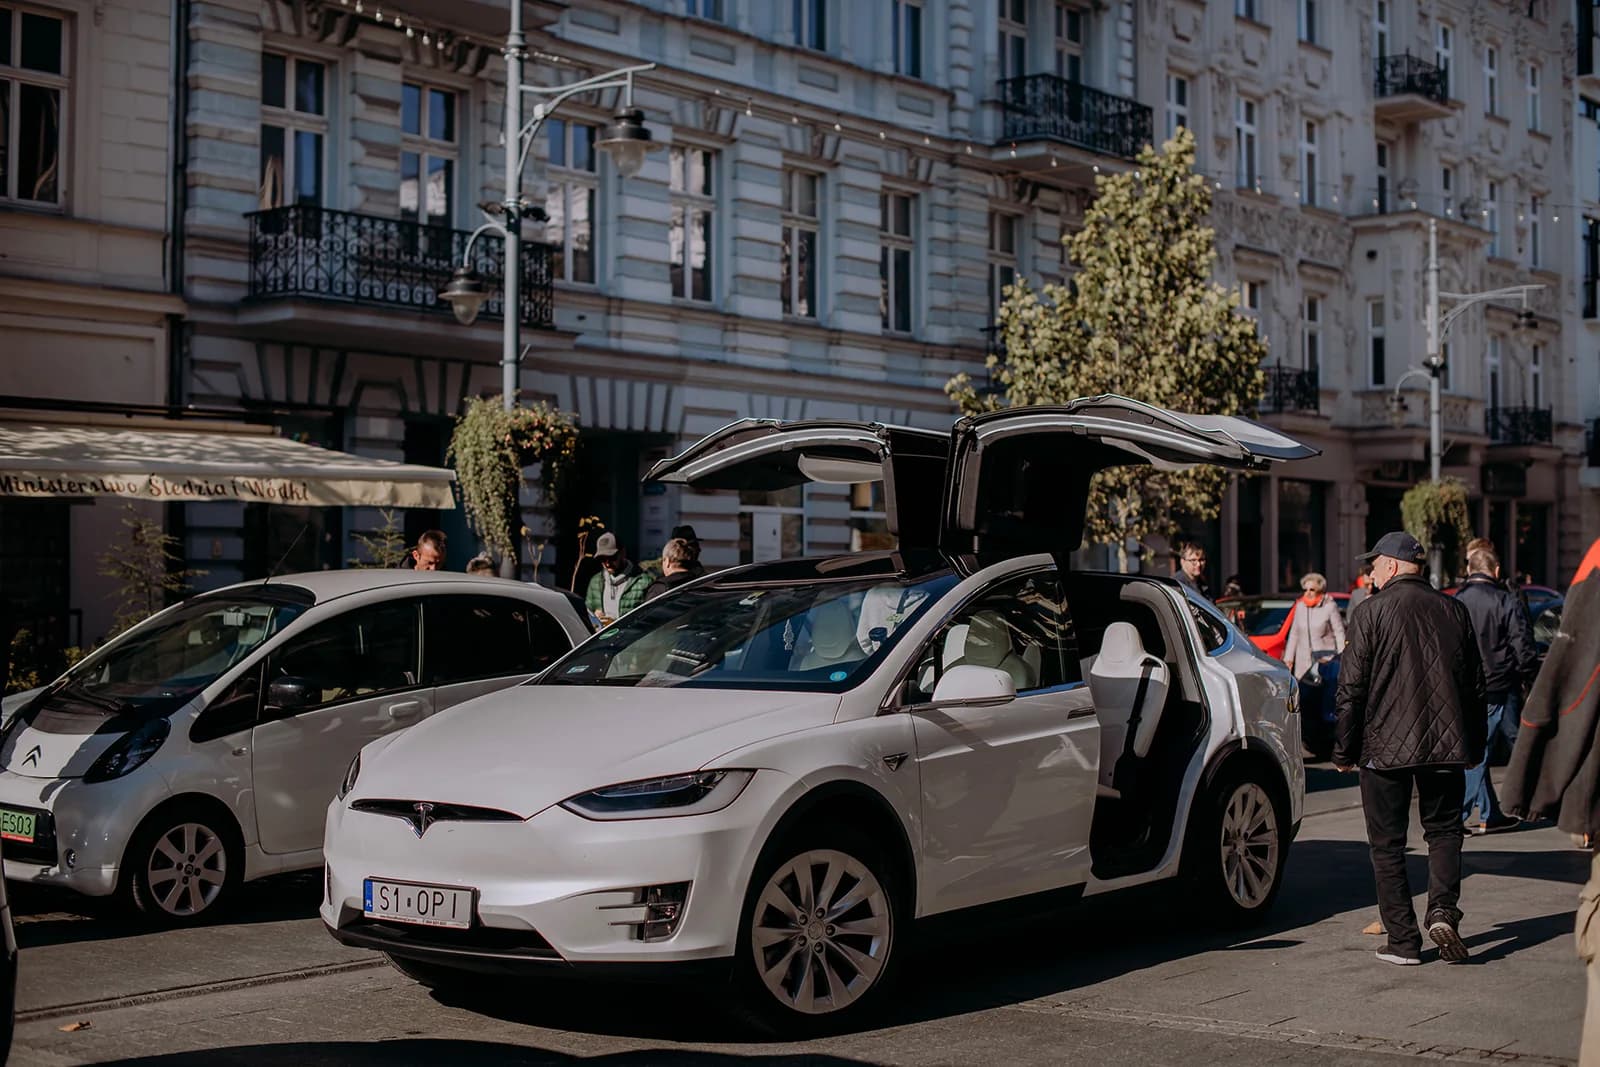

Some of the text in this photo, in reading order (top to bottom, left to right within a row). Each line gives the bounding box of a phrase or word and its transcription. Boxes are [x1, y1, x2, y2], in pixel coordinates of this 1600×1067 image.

[0, 472, 309, 501] Ministerstwo Śledzia i Wódki
